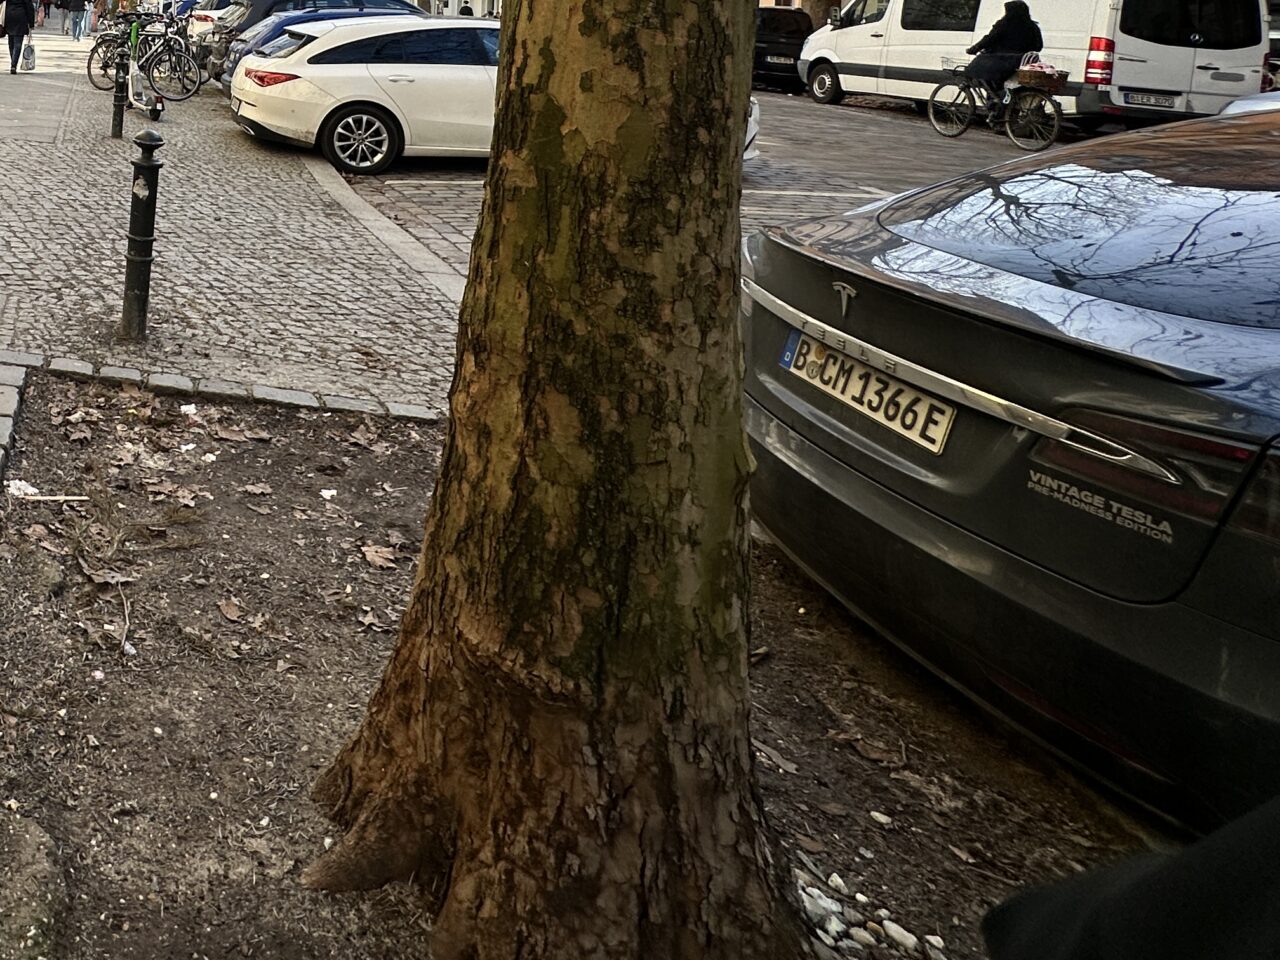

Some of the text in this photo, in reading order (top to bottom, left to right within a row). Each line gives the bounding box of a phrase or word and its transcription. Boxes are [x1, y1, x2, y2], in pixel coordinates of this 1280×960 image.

[1027, 481, 1173, 544] PRE-MADNESS EDITION
[1029, 469, 1173, 535] VINTAGE TESLA
